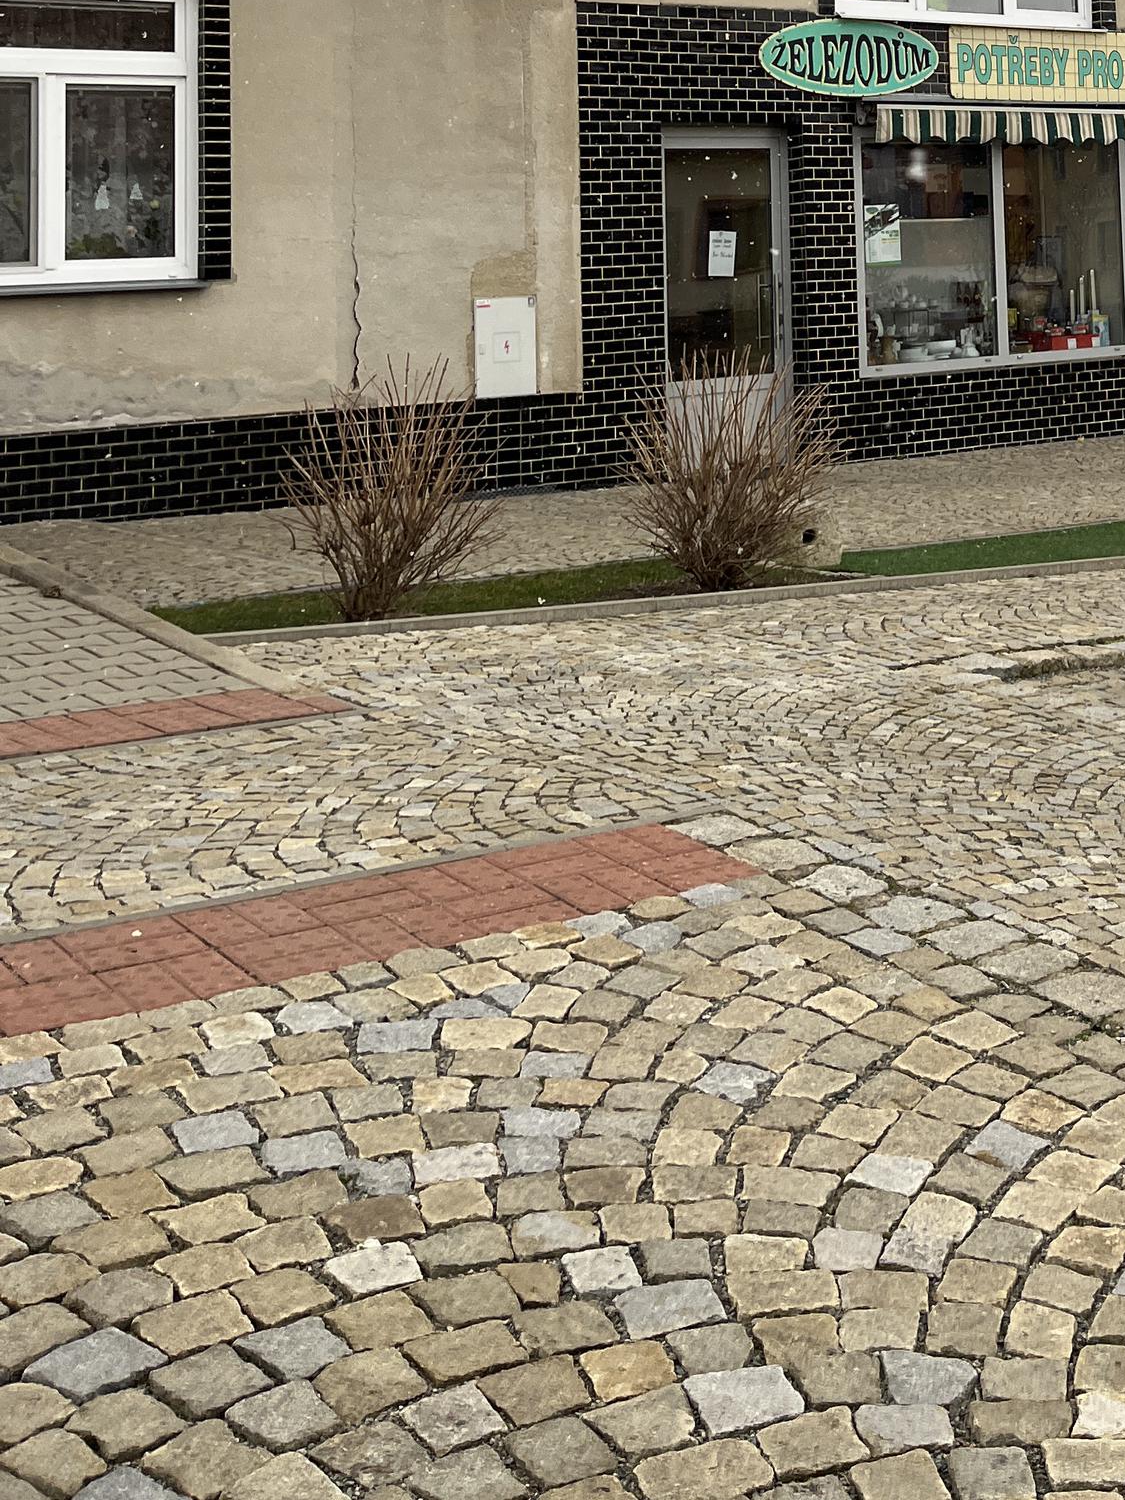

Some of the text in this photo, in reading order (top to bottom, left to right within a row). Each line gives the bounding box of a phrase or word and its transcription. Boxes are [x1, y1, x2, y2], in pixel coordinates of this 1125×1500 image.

[771, 32, 932, 87] ŽELEZODŮM
[956, 35, 1069, 86] POTŘEBY
[1077, 49, 1124, 89] PRO
